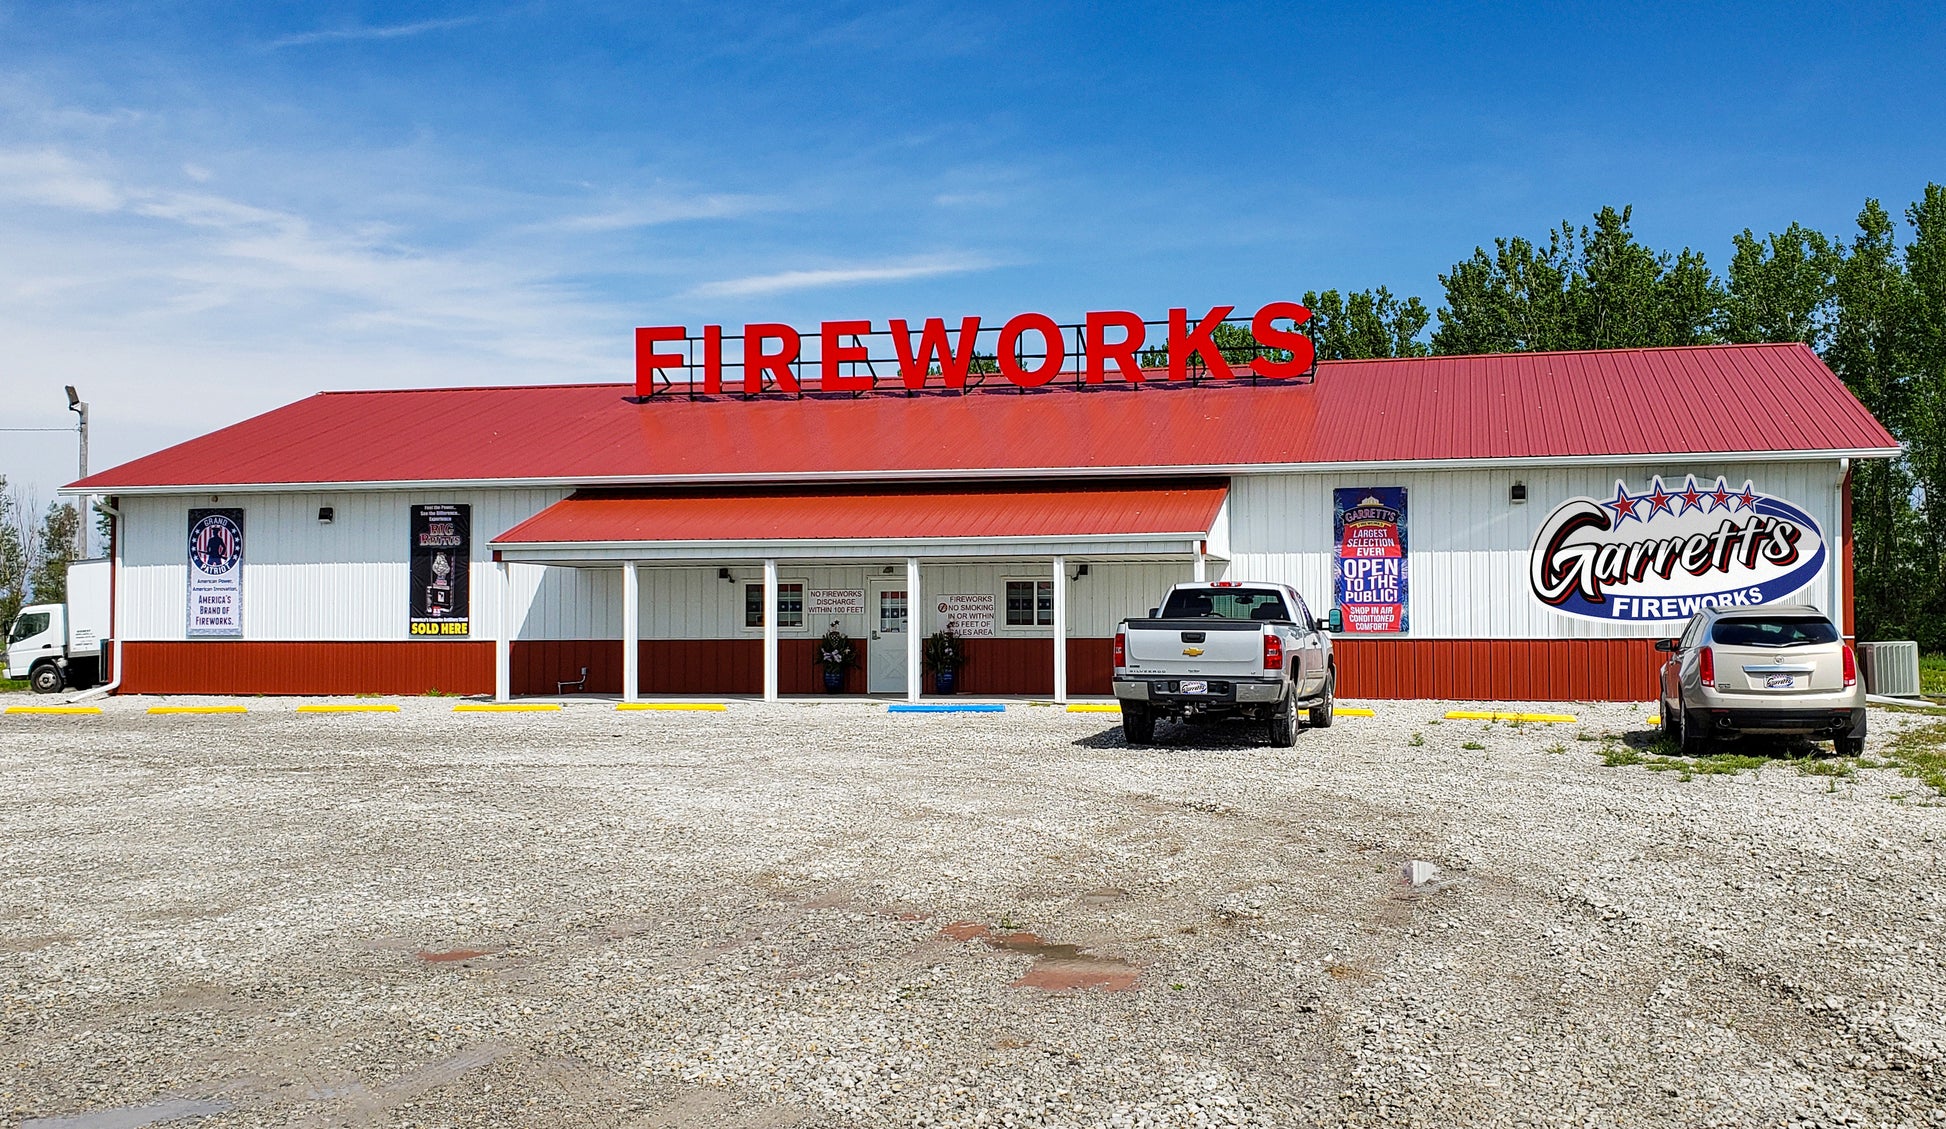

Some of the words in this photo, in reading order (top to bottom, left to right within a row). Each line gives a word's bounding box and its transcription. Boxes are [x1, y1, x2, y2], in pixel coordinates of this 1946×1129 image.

[635, 301, 1315, 396] FIREWORKS
[1344, 508, 1396, 523] GARRETT'S
[204, 517, 228, 526] GRAND
[429, 523, 454, 536] BIG
[1353, 529, 1388, 539] LARGEST
[1346, 538, 1395, 548] SELECTION
[1356, 547, 1385, 557] EVER!
[1530, 499, 1801, 605] Garrett's
[200, 563, 230, 575] PATRIOT
[1343, 559, 1399, 579] OPEN
[1345, 577, 1365, 592] TO
[1367, 574, 1399, 590] THE
[810, 590, 821, 598] NO
[822, 590, 863, 598] FIREWORKS
[949, 595, 993, 603] FIREWORKS
[1345, 588, 1398, 603] PUBLIC!
[198, 595, 232, 604] AMERICA'S
[816, 598, 856, 606] DISCHARGE
[1612, 587, 1763, 618] FIREWORKS
[200, 606, 221, 615] BRAND
[222, 606, 230, 615] OF
[1350, 606, 1370, 615] SHOP
[1371, 606, 1379, 615] IN
[1379, 606, 1393, 615] AIR
[195, 616, 234, 626] FIREWORKS.
[1349, 614, 1395, 623] CONDITIONED
[411, 622, 440, 635] SOLD
[441, 622, 468, 635] HERE
[961, 620, 979, 628] FEET
[980, 620, 991, 628] OF
[1355, 622, 1389, 631] COMFORT!
[973, 628, 994, 636] AREA
